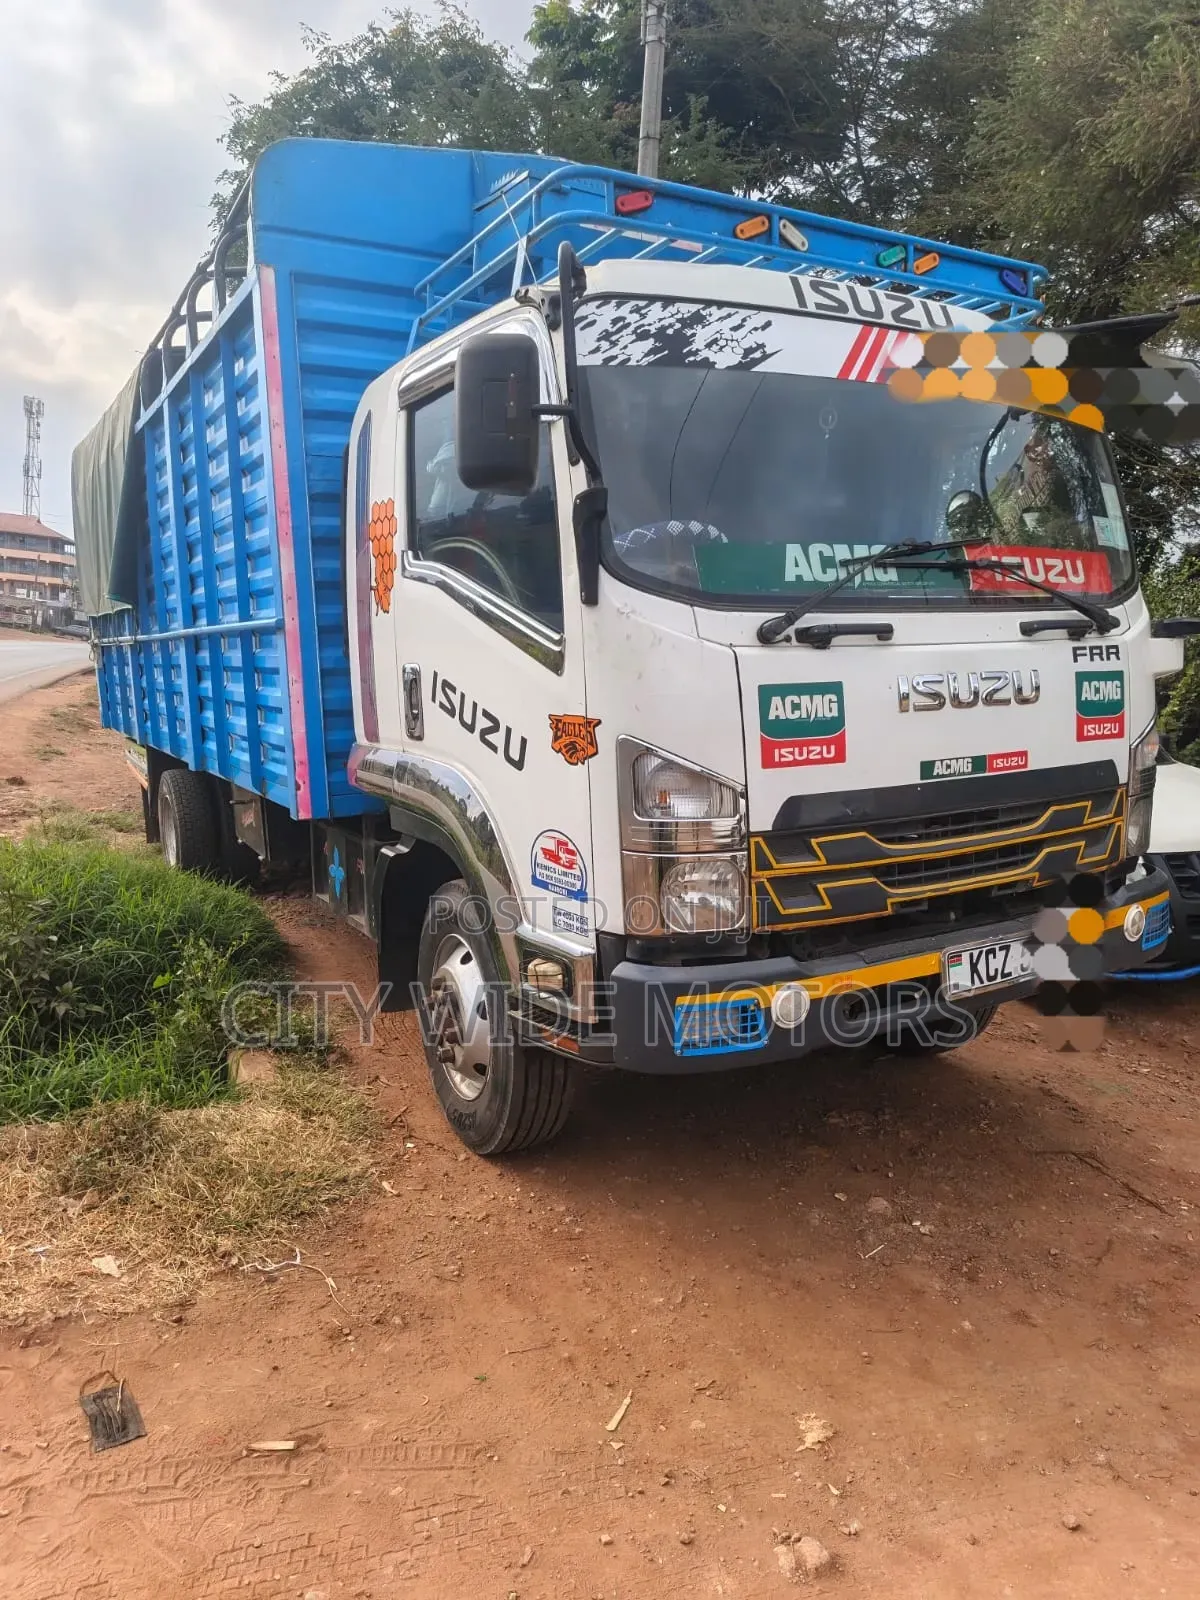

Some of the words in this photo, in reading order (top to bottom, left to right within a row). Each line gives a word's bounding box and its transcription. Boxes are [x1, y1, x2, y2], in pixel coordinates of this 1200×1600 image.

[789, 275, 955, 329] ISUZU
[1072, 645, 1120, 663] FRR
[897, 669, 1041, 713] ISUZU
[1081, 680, 1121, 703] ACMG
[431, 669, 528, 771] ISUZU
[768, 694, 839, 722] ACMG
[554, 718, 595, 745] EAGLES
[1083, 722, 1119, 737] ISUZU
[774, 744, 836, 762] ISUZU
[933, 757, 973, 776] ACMG
[993, 755, 1026, 769] ISUZU
[557, 869, 582, 882] LIMITED
[969, 944, 1013, 986] KCZ
